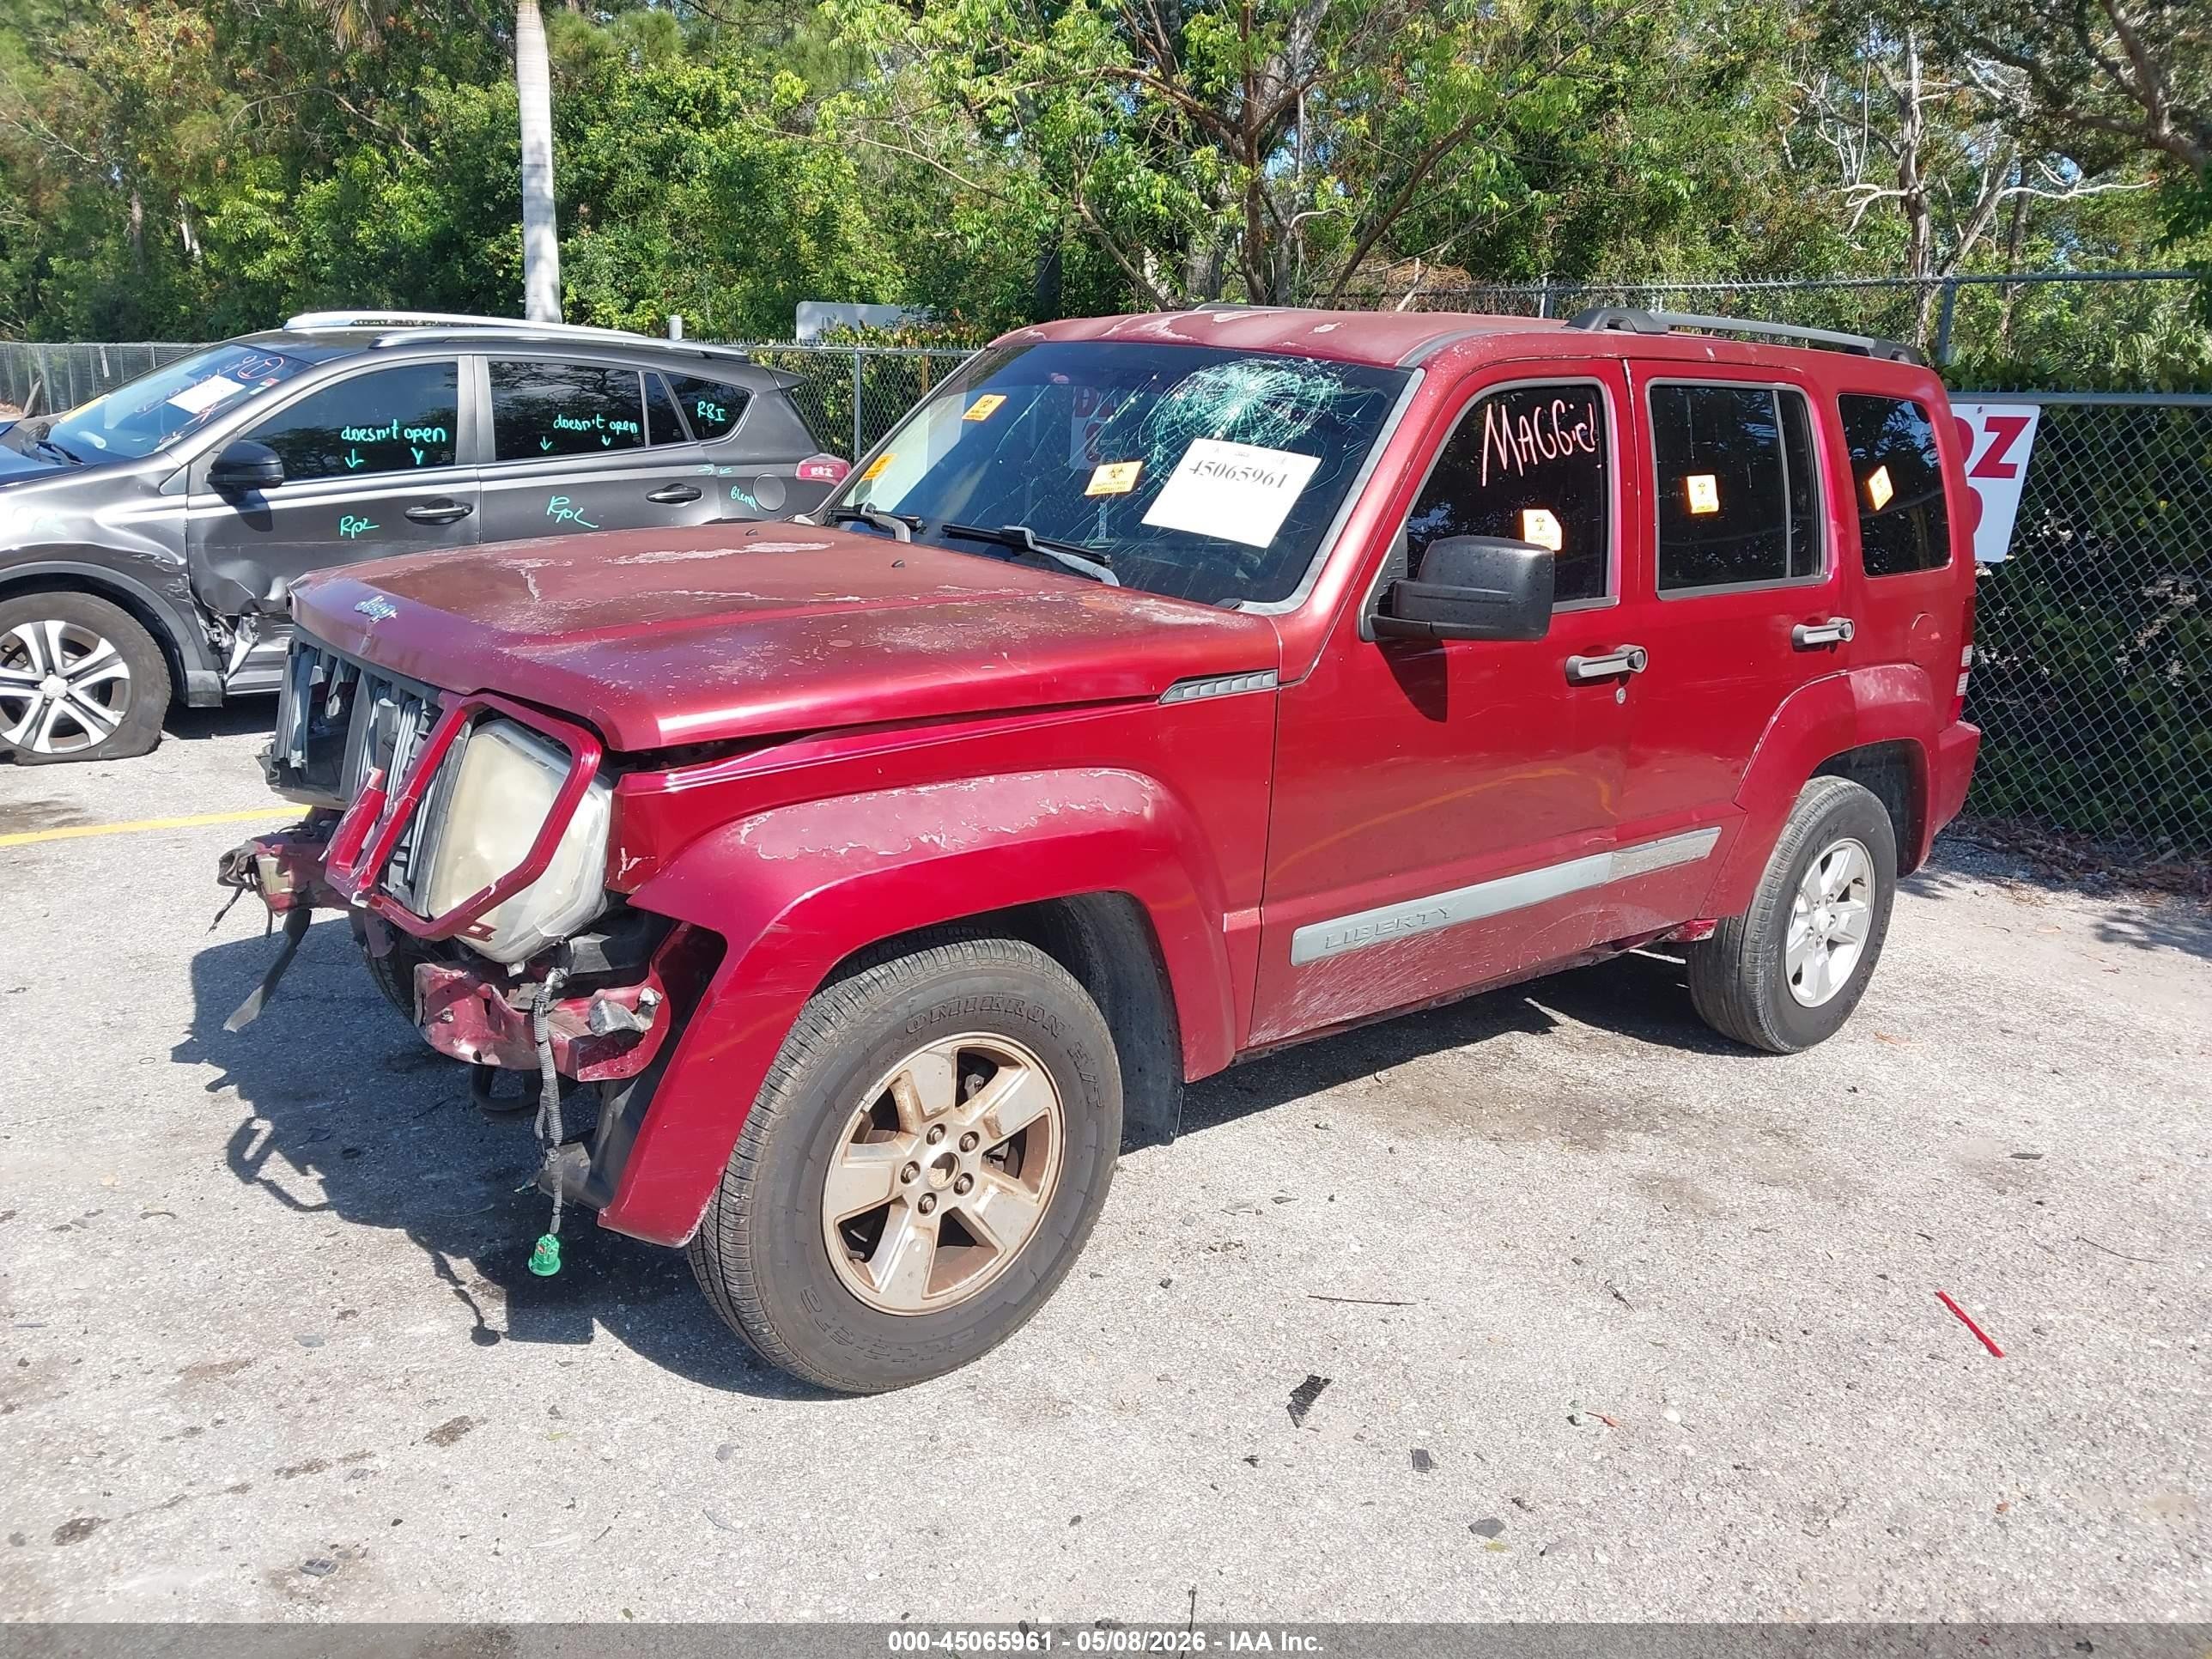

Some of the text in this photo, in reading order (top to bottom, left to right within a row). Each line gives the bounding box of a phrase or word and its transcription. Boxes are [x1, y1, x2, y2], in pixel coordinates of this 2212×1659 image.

[341, 418, 446, 443] doesn't open
[552, 413, 637, 435] doesn't open
[1188, 459, 1288, 489] 45065961
[1325, 905, 1460, 950] LIBERTY
